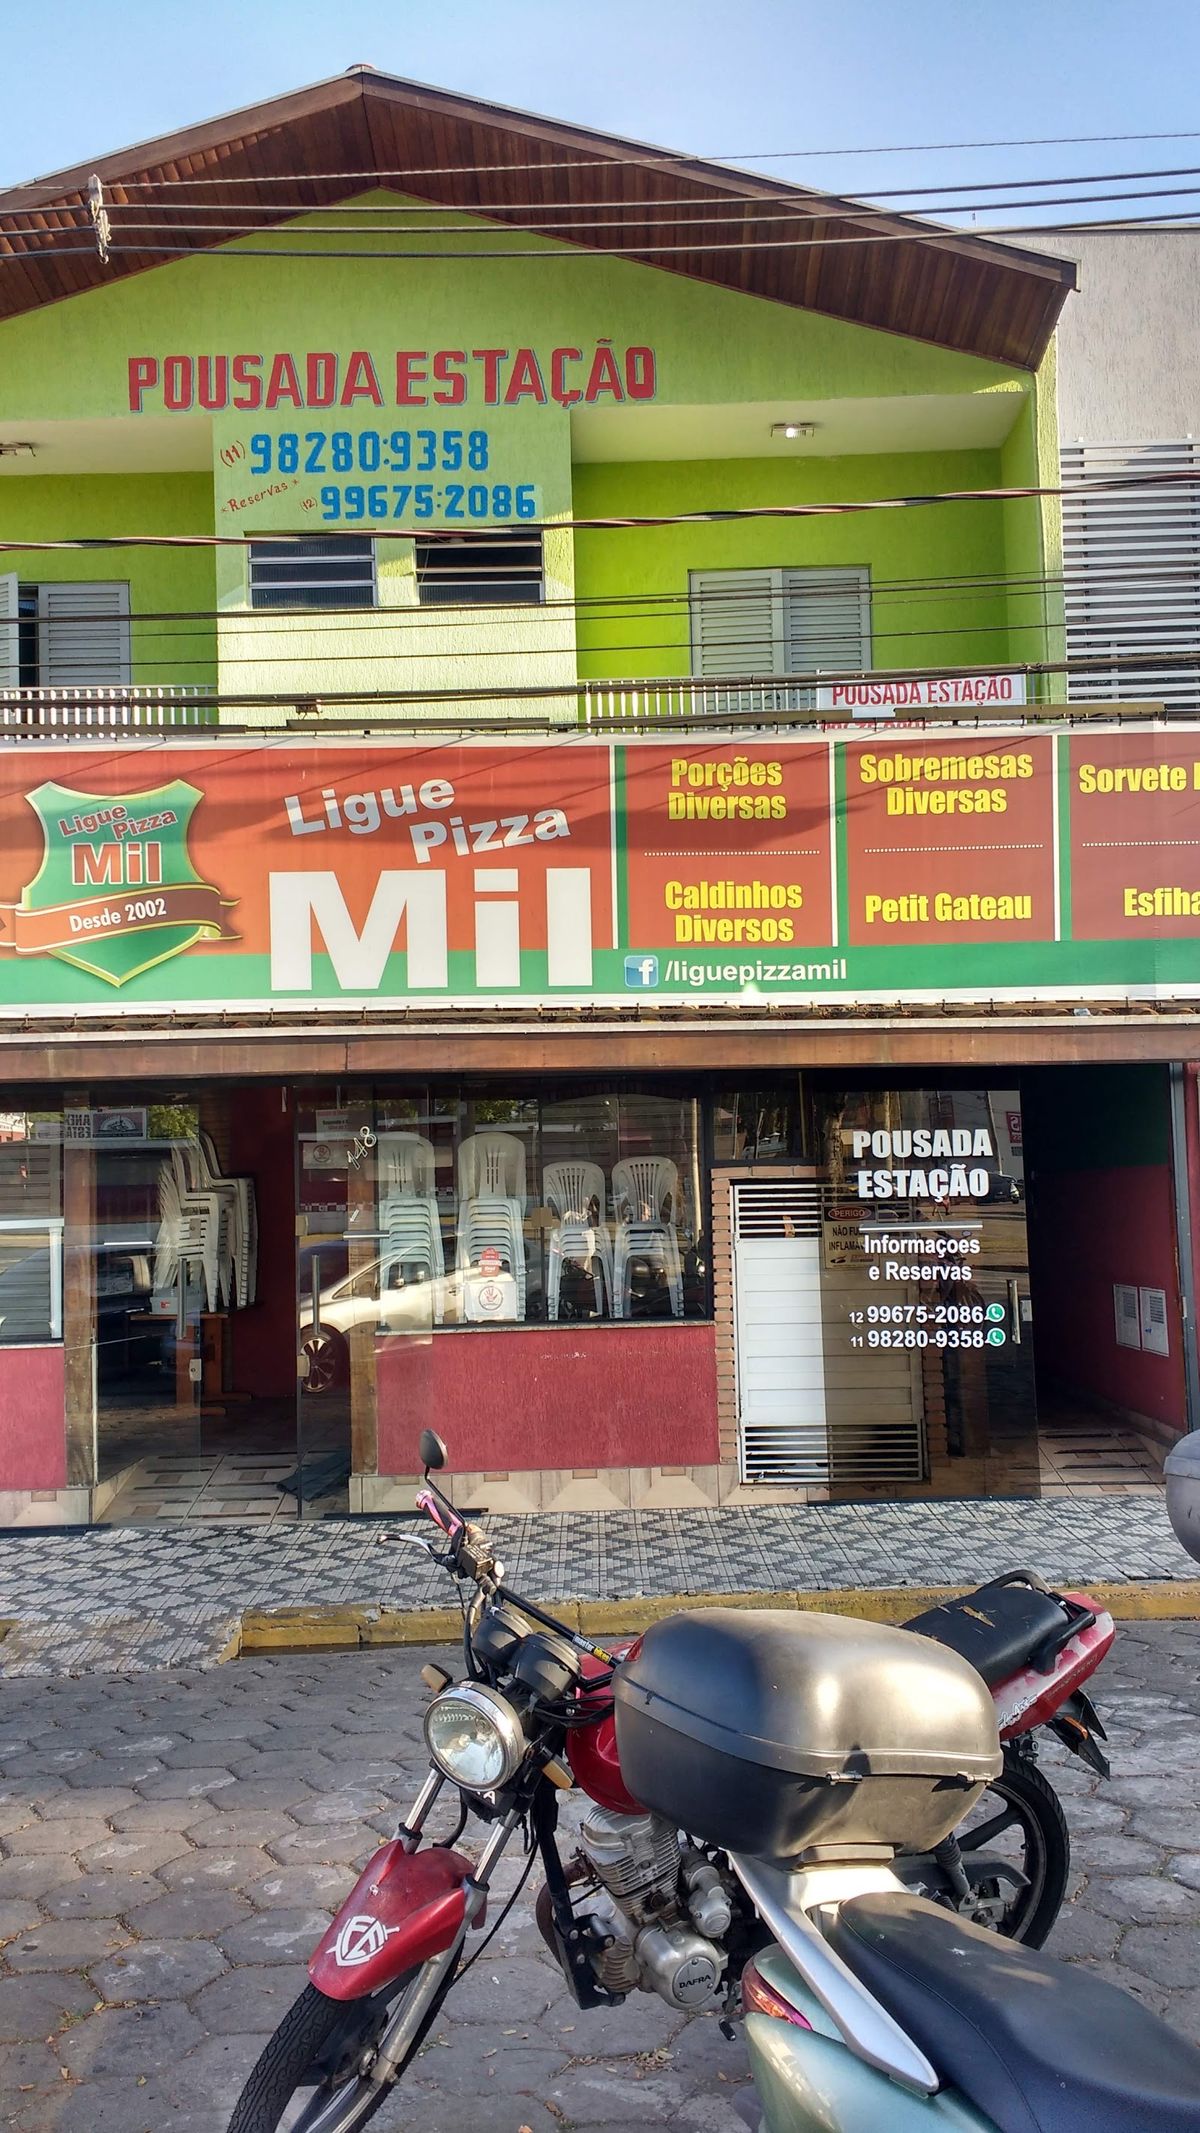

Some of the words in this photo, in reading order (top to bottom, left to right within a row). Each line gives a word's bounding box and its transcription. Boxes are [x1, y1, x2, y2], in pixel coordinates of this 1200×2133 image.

[128, 351, 384, 412] POUSADA
[396, 338, 656, 409] ESTAÇÃO
[219, 441, 245, 467] (11)
[250, 430, 489, 474] 98280:9358
[300, 496, 318, 513] (12)
[321, 484, 536, 520] 99675:2086
[832, 681, 921, 706] POUSADA
[927, 676, 1012, 706] ESTAÇÃO
[671, 757, 783, 792] Porções
[859, 753, 1033, 784] Sobremesas
[1079, 764, 1187, 793] Sorvete
[283, 777, 456, 836] Ligue
[668, 789, 787, 820] Diversas
[887, 787, 1007, 816] Diversas
[59, 805, 127, 837] Ligue
[112, 810, 178, 840] Pizza
[409, 808, 571, 864] Pizza
[72, 841, 162, 885] Mil
[665, 880, 803, 909] Caldinhos
[865, 894, 929, 924] Petit
[934, 893, 1032, 922] Gateau
[69, 907, 121, 932] Desde
[125, 898, 167, 922] 2002
[269, 868, 592, 991] Mil
[674, 913, 794, 943] Diversos
[665, 959, 847, 986] /liguepizzamil
[347, 1126, 377, 1170] 148
[853, 1129, 993, 1158] POUSADA
[858, 1163, 989, 1202] ESTAÇÃO
[834, 1208, 866, 1217] PERIGO
[832, 1224, 848, 1237] NÃO
[864, 1234, 980, 1258] Informaçoes
[869, 1265, 880, 1280] e
[885, 1261, 972, 1280] Reservas
[849, 1312, 864, 1323] 12
[867, 1305, 984, 1324] 99675-2086
[850, 1336, 863, 1347] 11
[868, 1330, 984, 1348] 98280-9358
[679, 1975, 711, 1988] DAFRA
